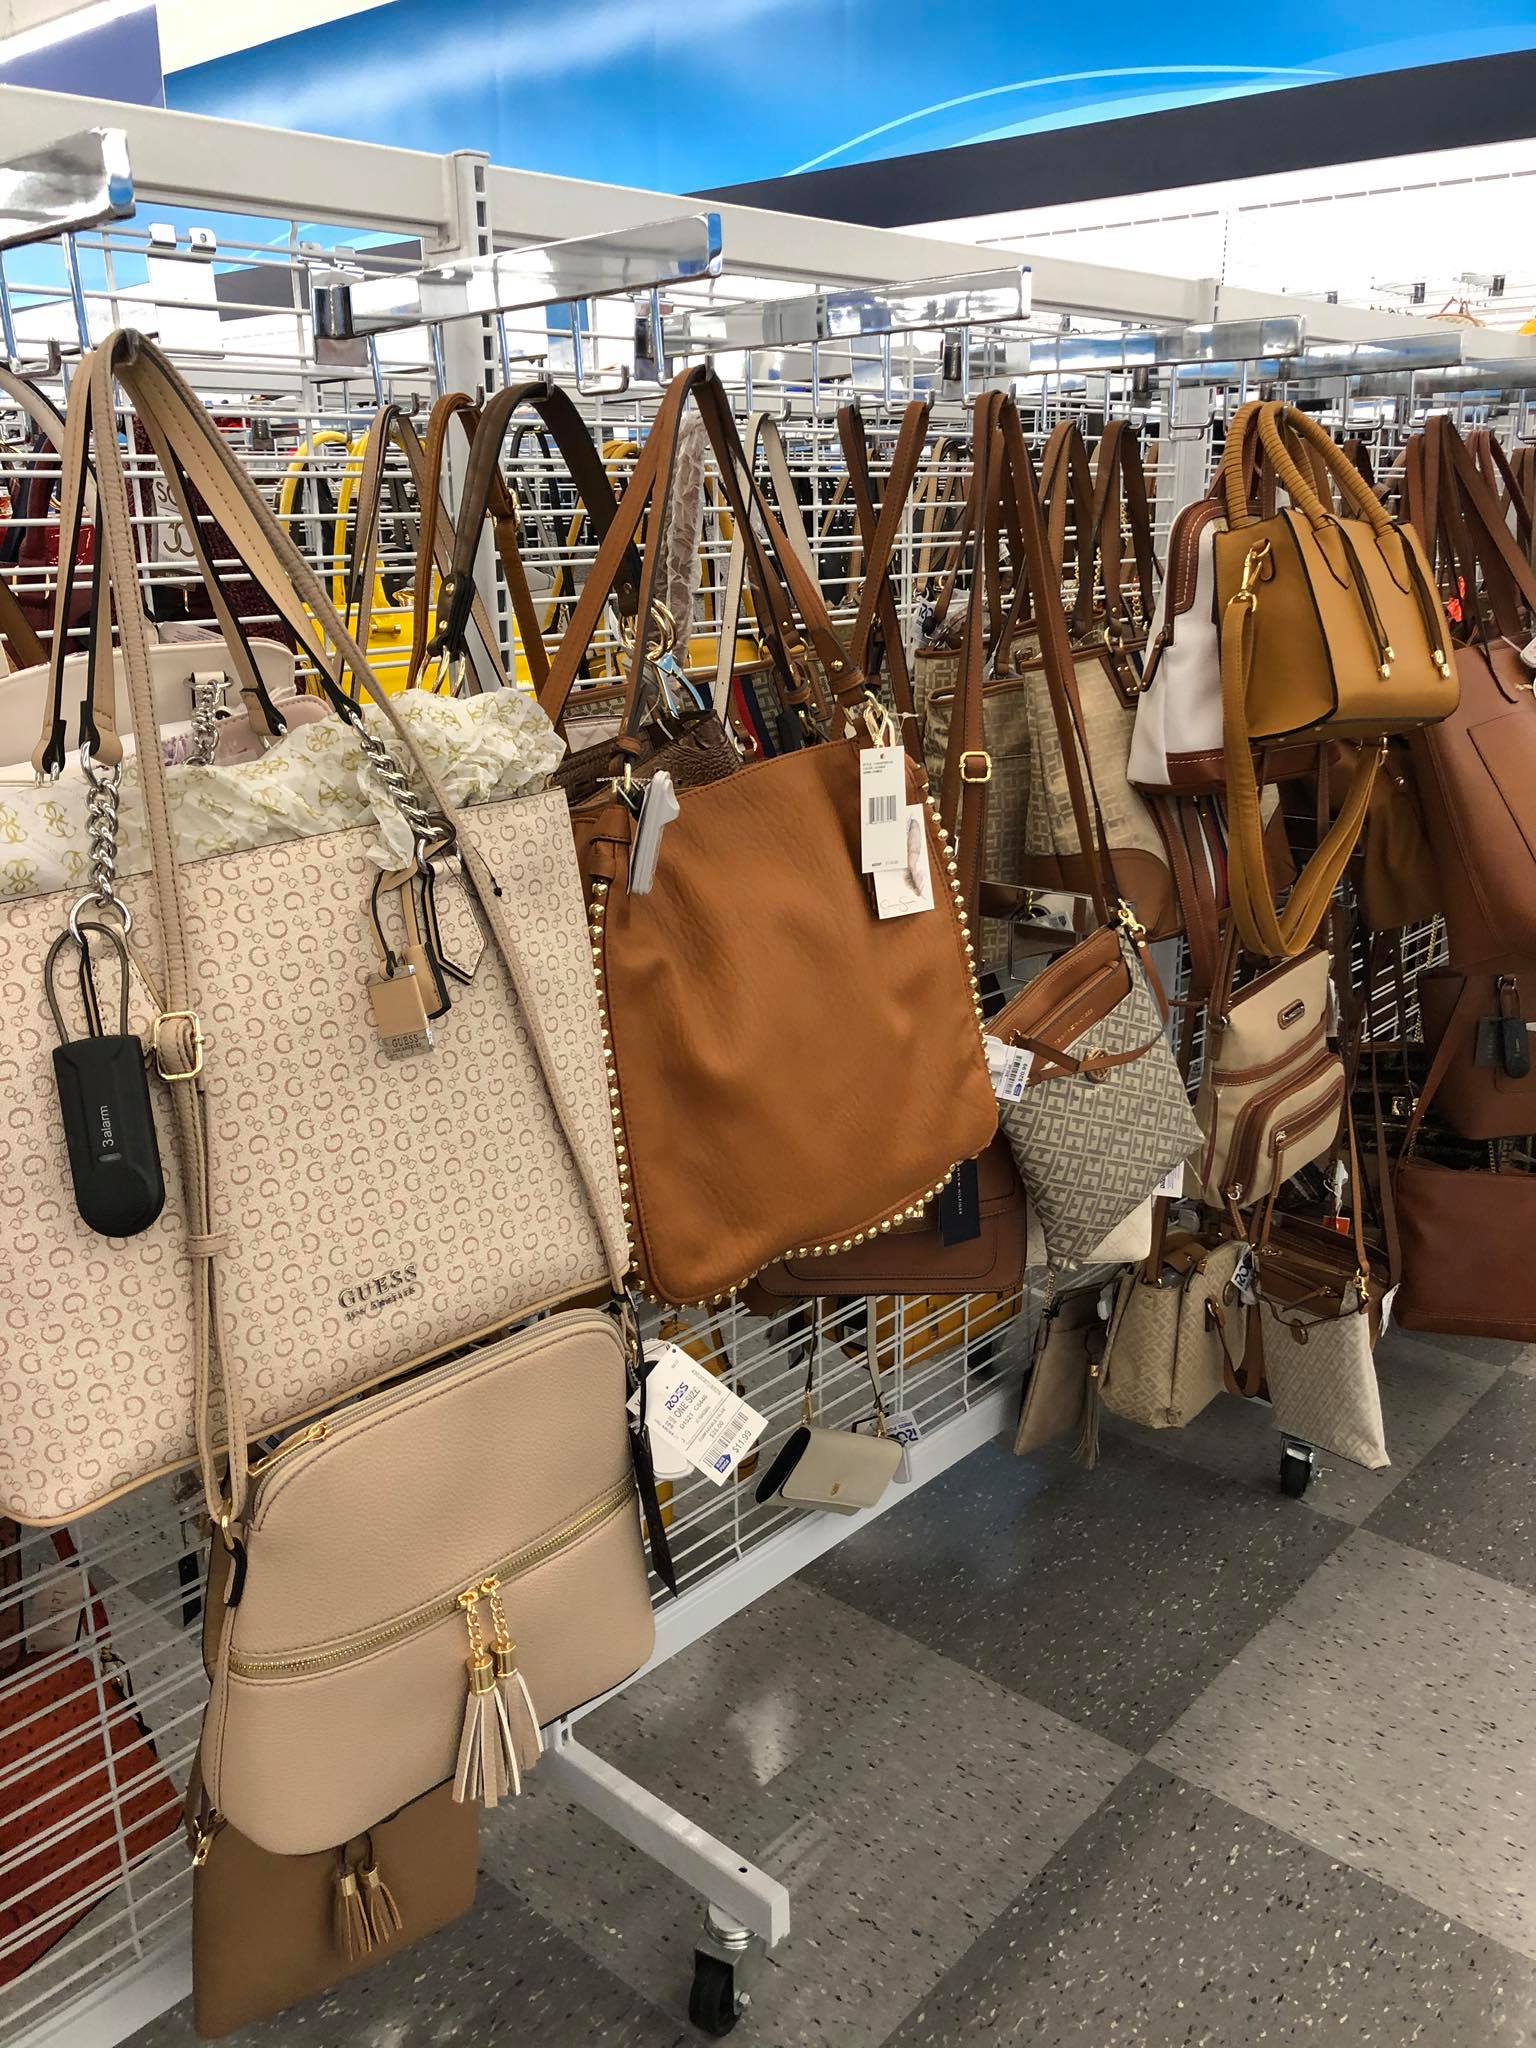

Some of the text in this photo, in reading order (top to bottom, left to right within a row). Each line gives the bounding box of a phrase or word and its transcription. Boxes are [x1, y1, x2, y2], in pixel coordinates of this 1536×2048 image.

[391, 1033, 419, 1048] GUESS
[337, 1263, 418, 1308] GUESS
[664, 1382, 689, 1411] ROSS
[673, 1386, 701, 1418] ONE SIZE
[731, 1429, 752, 1454] $11.99
